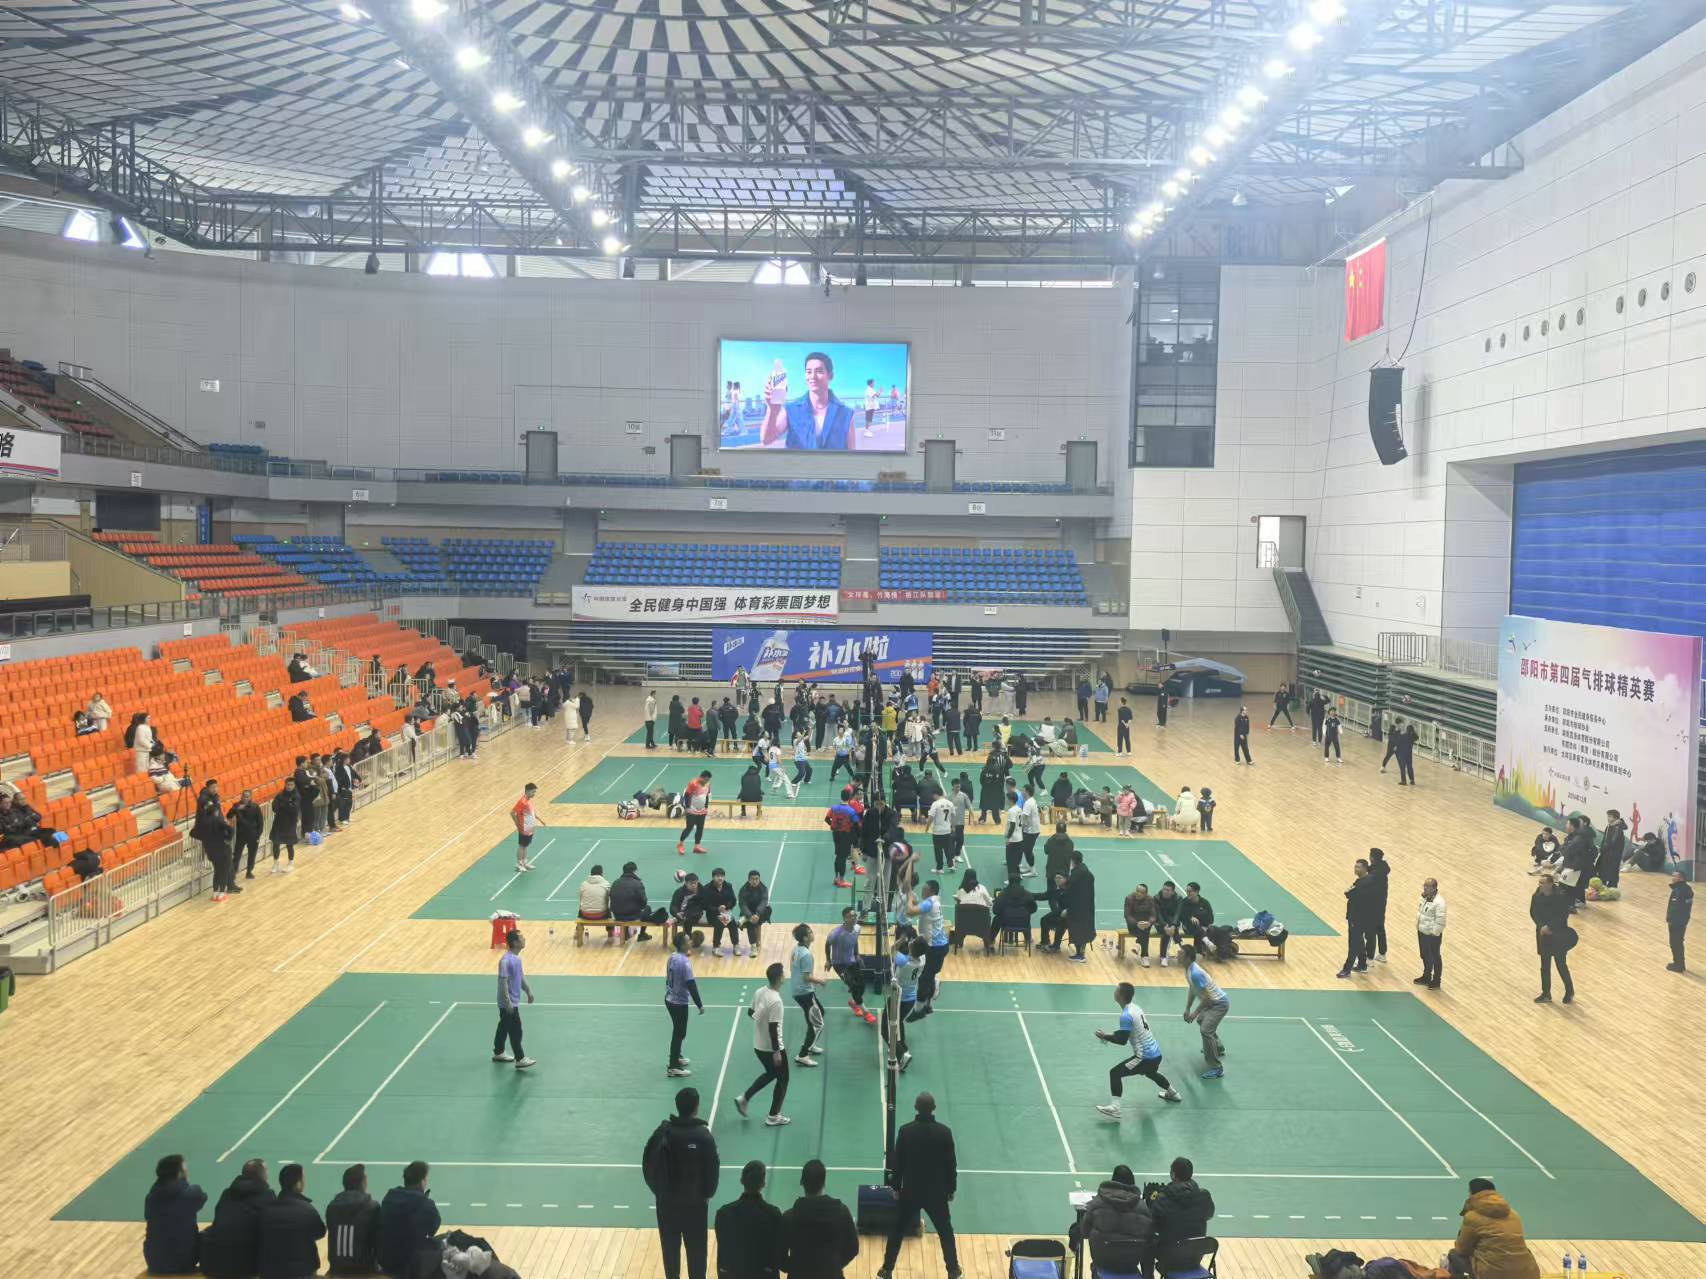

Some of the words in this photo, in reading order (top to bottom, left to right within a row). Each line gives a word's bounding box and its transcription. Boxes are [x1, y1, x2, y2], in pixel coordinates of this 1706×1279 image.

[629, 597, 727, 613] 全民健身中国强
[734, 594, 831, 611] 体育彩票圆梦想
[809, 635, 888, 671] 补水啦
[1521, 658, 1655, 702] 邵阳市第四届气排球精英赛
[943, 809, 950, 820] 7
